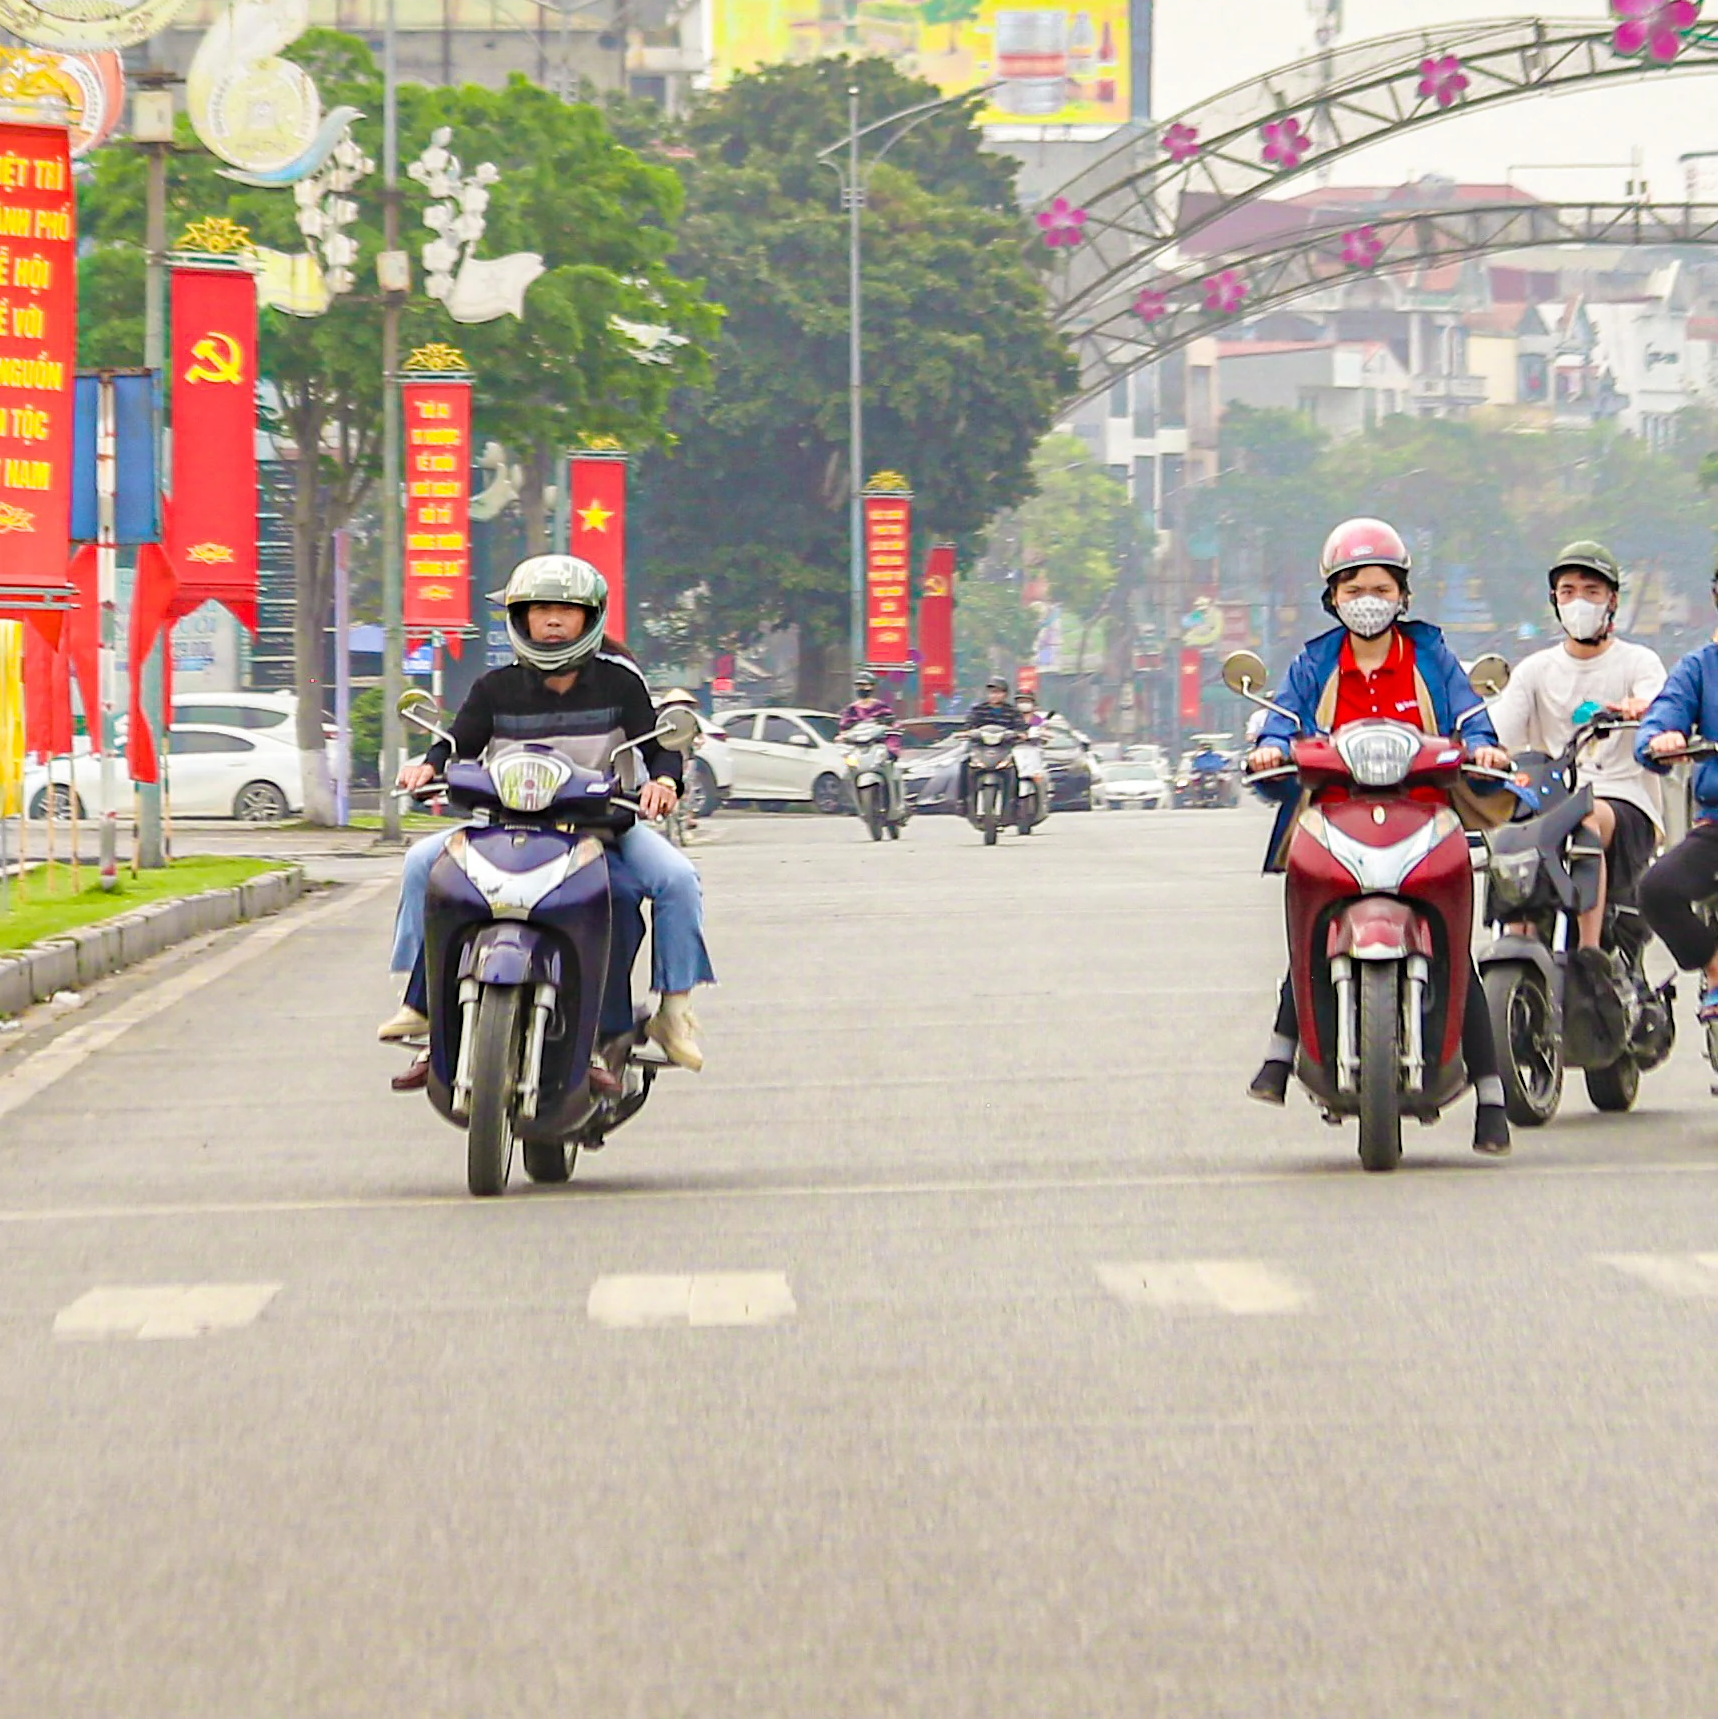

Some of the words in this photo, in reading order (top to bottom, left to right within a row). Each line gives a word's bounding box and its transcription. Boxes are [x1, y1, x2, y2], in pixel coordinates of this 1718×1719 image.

[32, 155, 66, 192] TRÌ
[33, 201, 73, 243] PHỐ
[13, 252, 52, 296] HỘI
[9, 402, 50, 447] TỘC
[5, 457, 52, 492] NAM
